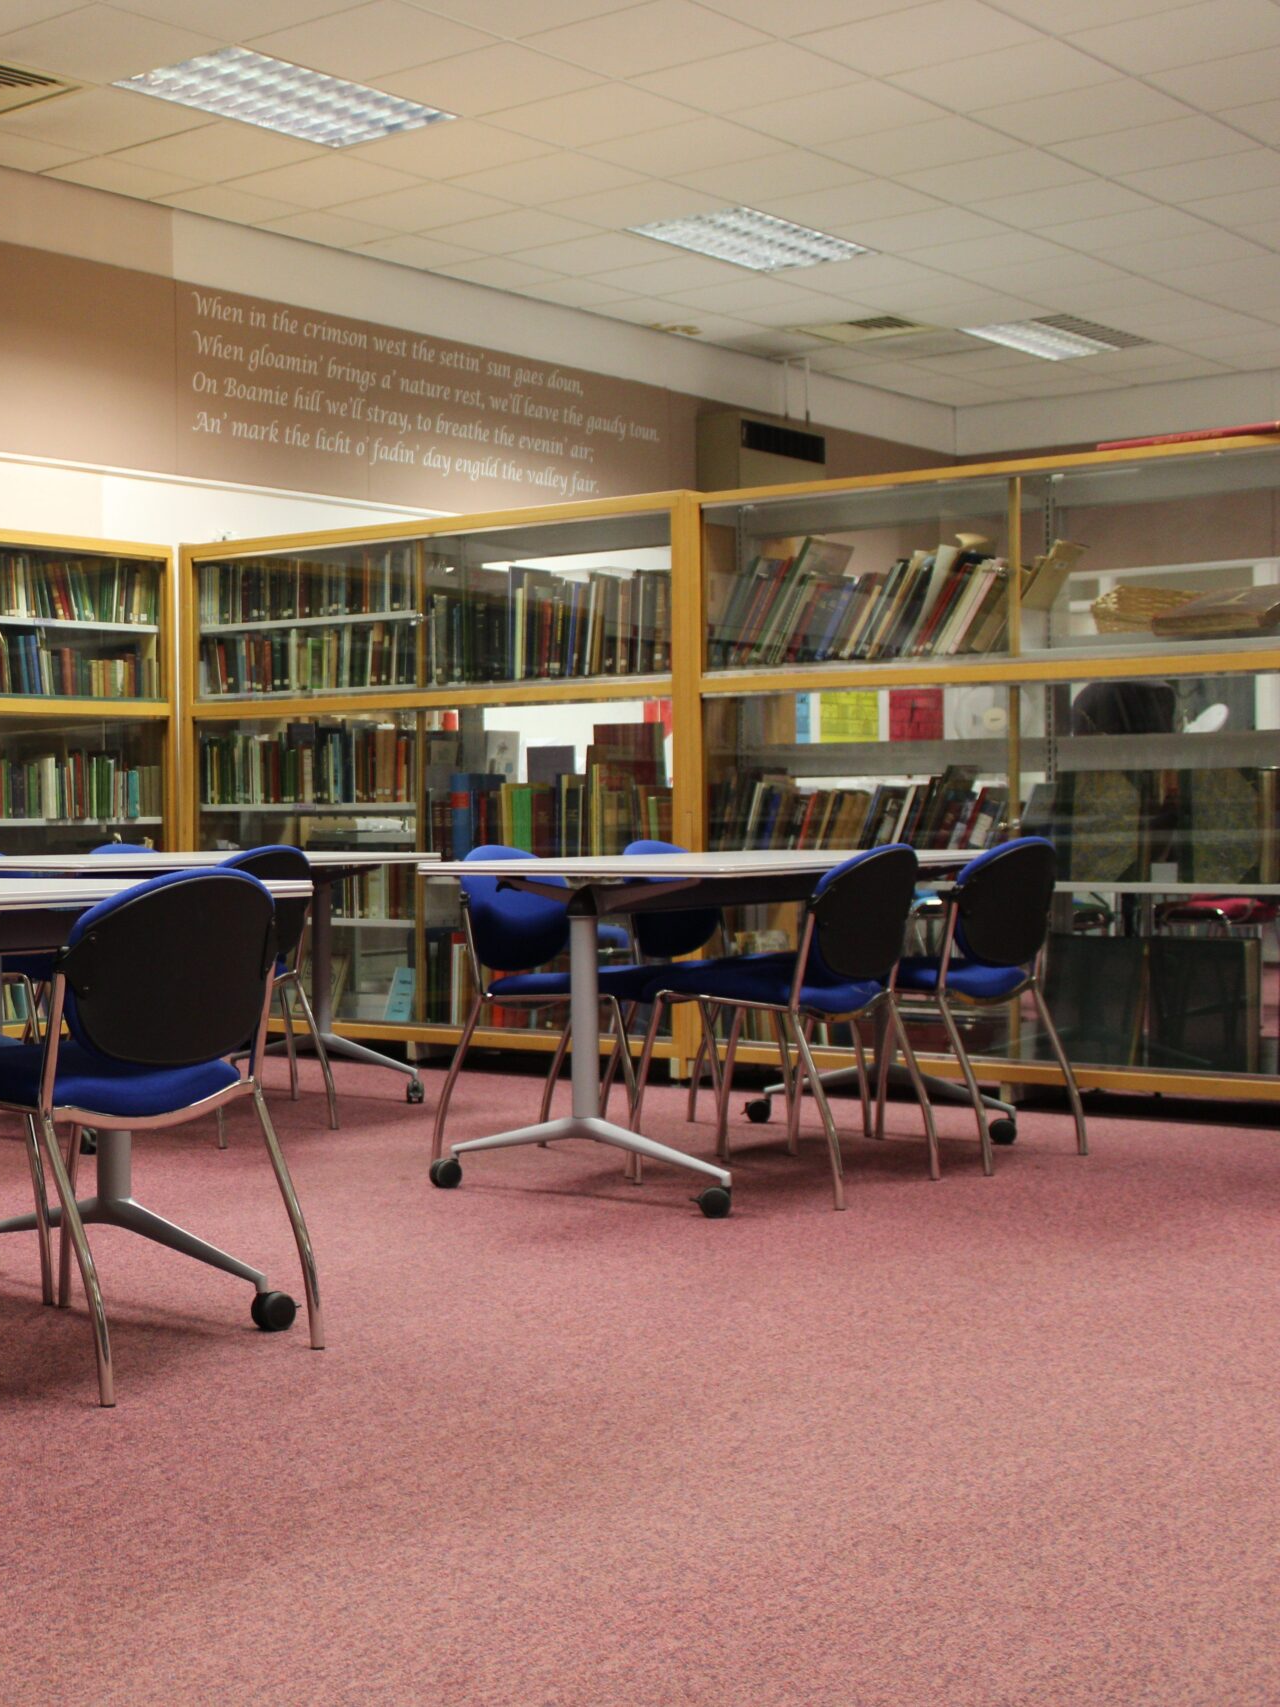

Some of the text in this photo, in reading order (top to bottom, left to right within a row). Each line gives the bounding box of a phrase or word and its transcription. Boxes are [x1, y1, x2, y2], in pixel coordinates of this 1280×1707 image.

[192, 291, 584, 397] When in the crimson west the settin' sun gaes doun,
[192, 330, 244, 363] When
[249, 343, 324, 376] gloamin'
[327, 357, 377, 391] brings
[380, 369, 397, 390] a'
[400, 377, 450, 401] nature
[455, 385, 485, 410] rest,
[489, 393, 523, 415] we'll
[523, 397, 559, 422] leave
[563, 405, 583, 427] the
[587, 415, 626, 442] gaudy
[192, 371, 217, 395] On
[224, 376, 288, 407] Boamie
[294, 386, 324, 413] hill
[326, 397, 366, 420] we'll
[366, 404, 412, 434] stray,
[416, 413, 431, 432] to
[436, 413, 489, 443] breathe
[494, 425, 514, 448] the
[518, 436, 568, 457] evenin'
[192, 411, 600, 497] An' mark the licht o' fadin' day engild the valley fair.
